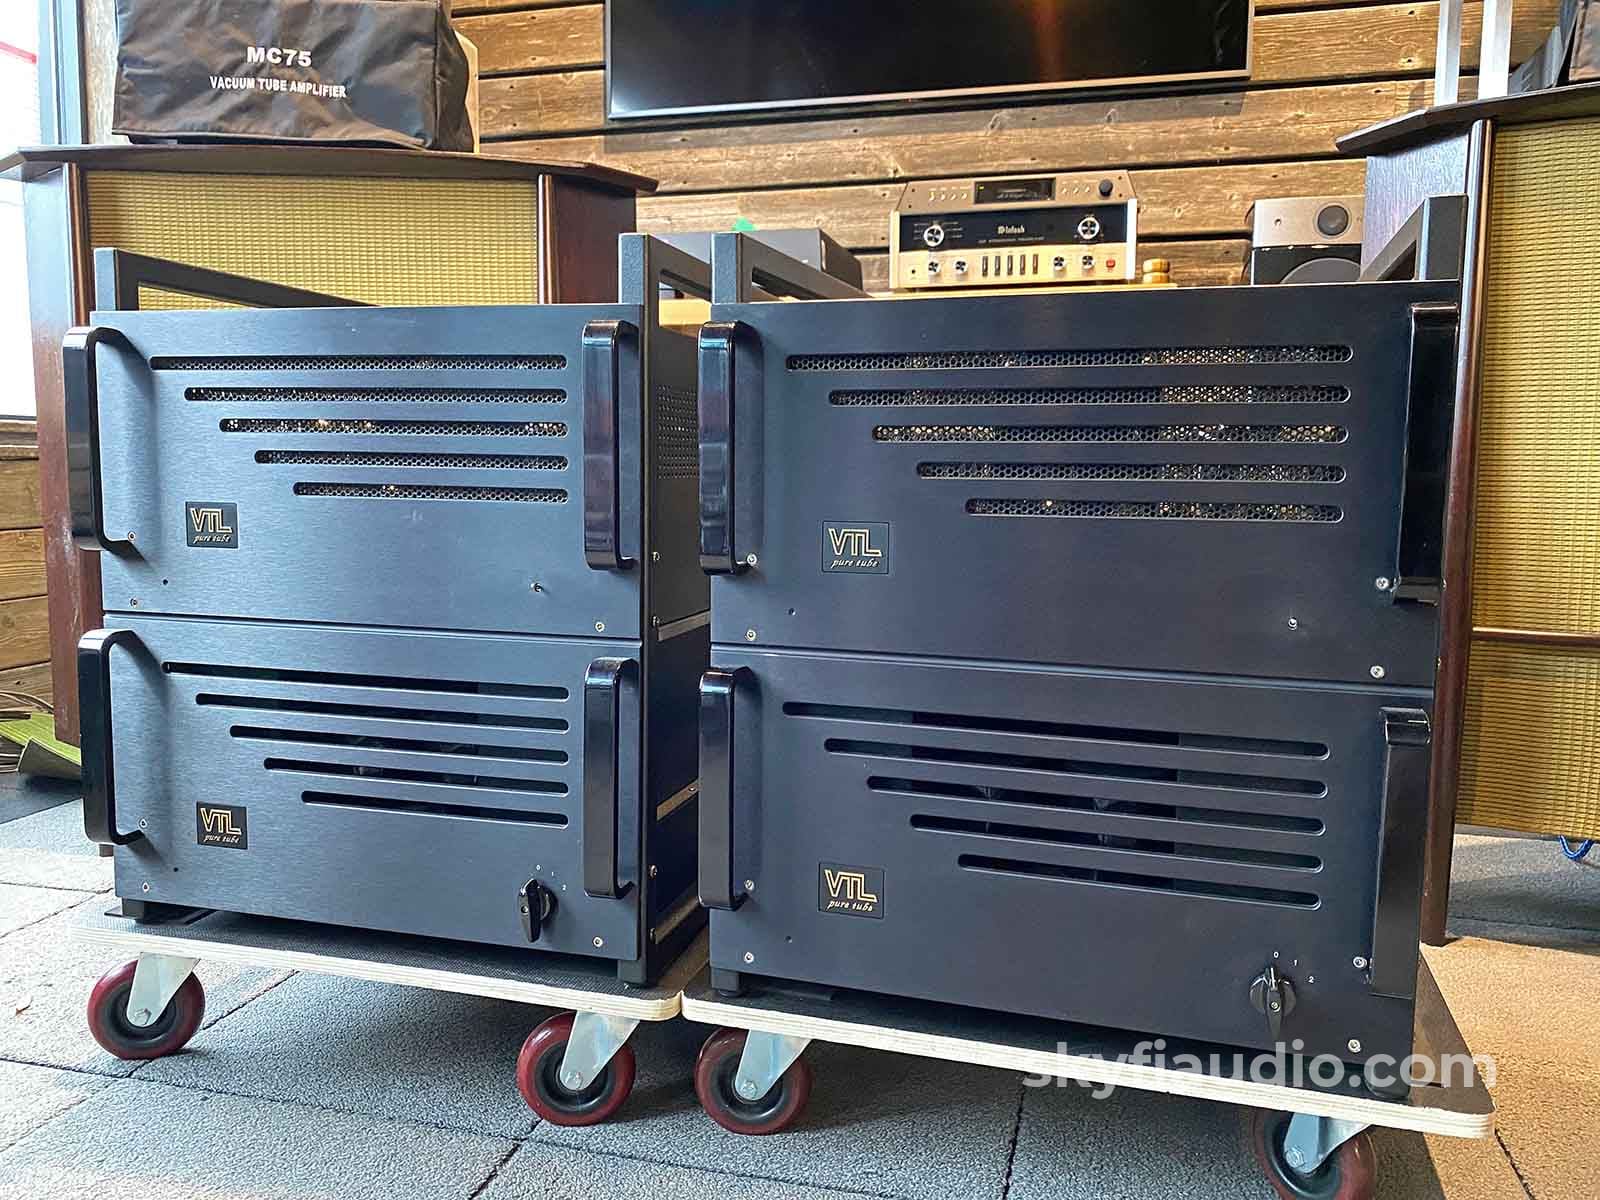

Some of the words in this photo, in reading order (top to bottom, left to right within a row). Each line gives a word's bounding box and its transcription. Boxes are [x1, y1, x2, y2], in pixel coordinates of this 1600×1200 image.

[246, 46, 312, 67] MC75
[209, 76, 255, 89] VACUUM
[257, 78, 287, 92] TUBE
[289, 80, 347, 98] AMPLIFIER
[190, 508, 233, 533] VTL
[828, 528, 882, 557] VTL
[831, 559, 853, 569] pure
[856, 558, 878, 568] tube
[200, 807, 242, 835] VTL
[824, 868, 878, 903] VTL
[827, 900, 849, 910] pure
[852, 902, 873, 912] tube
[1308, 975, 1315, 984] 2
